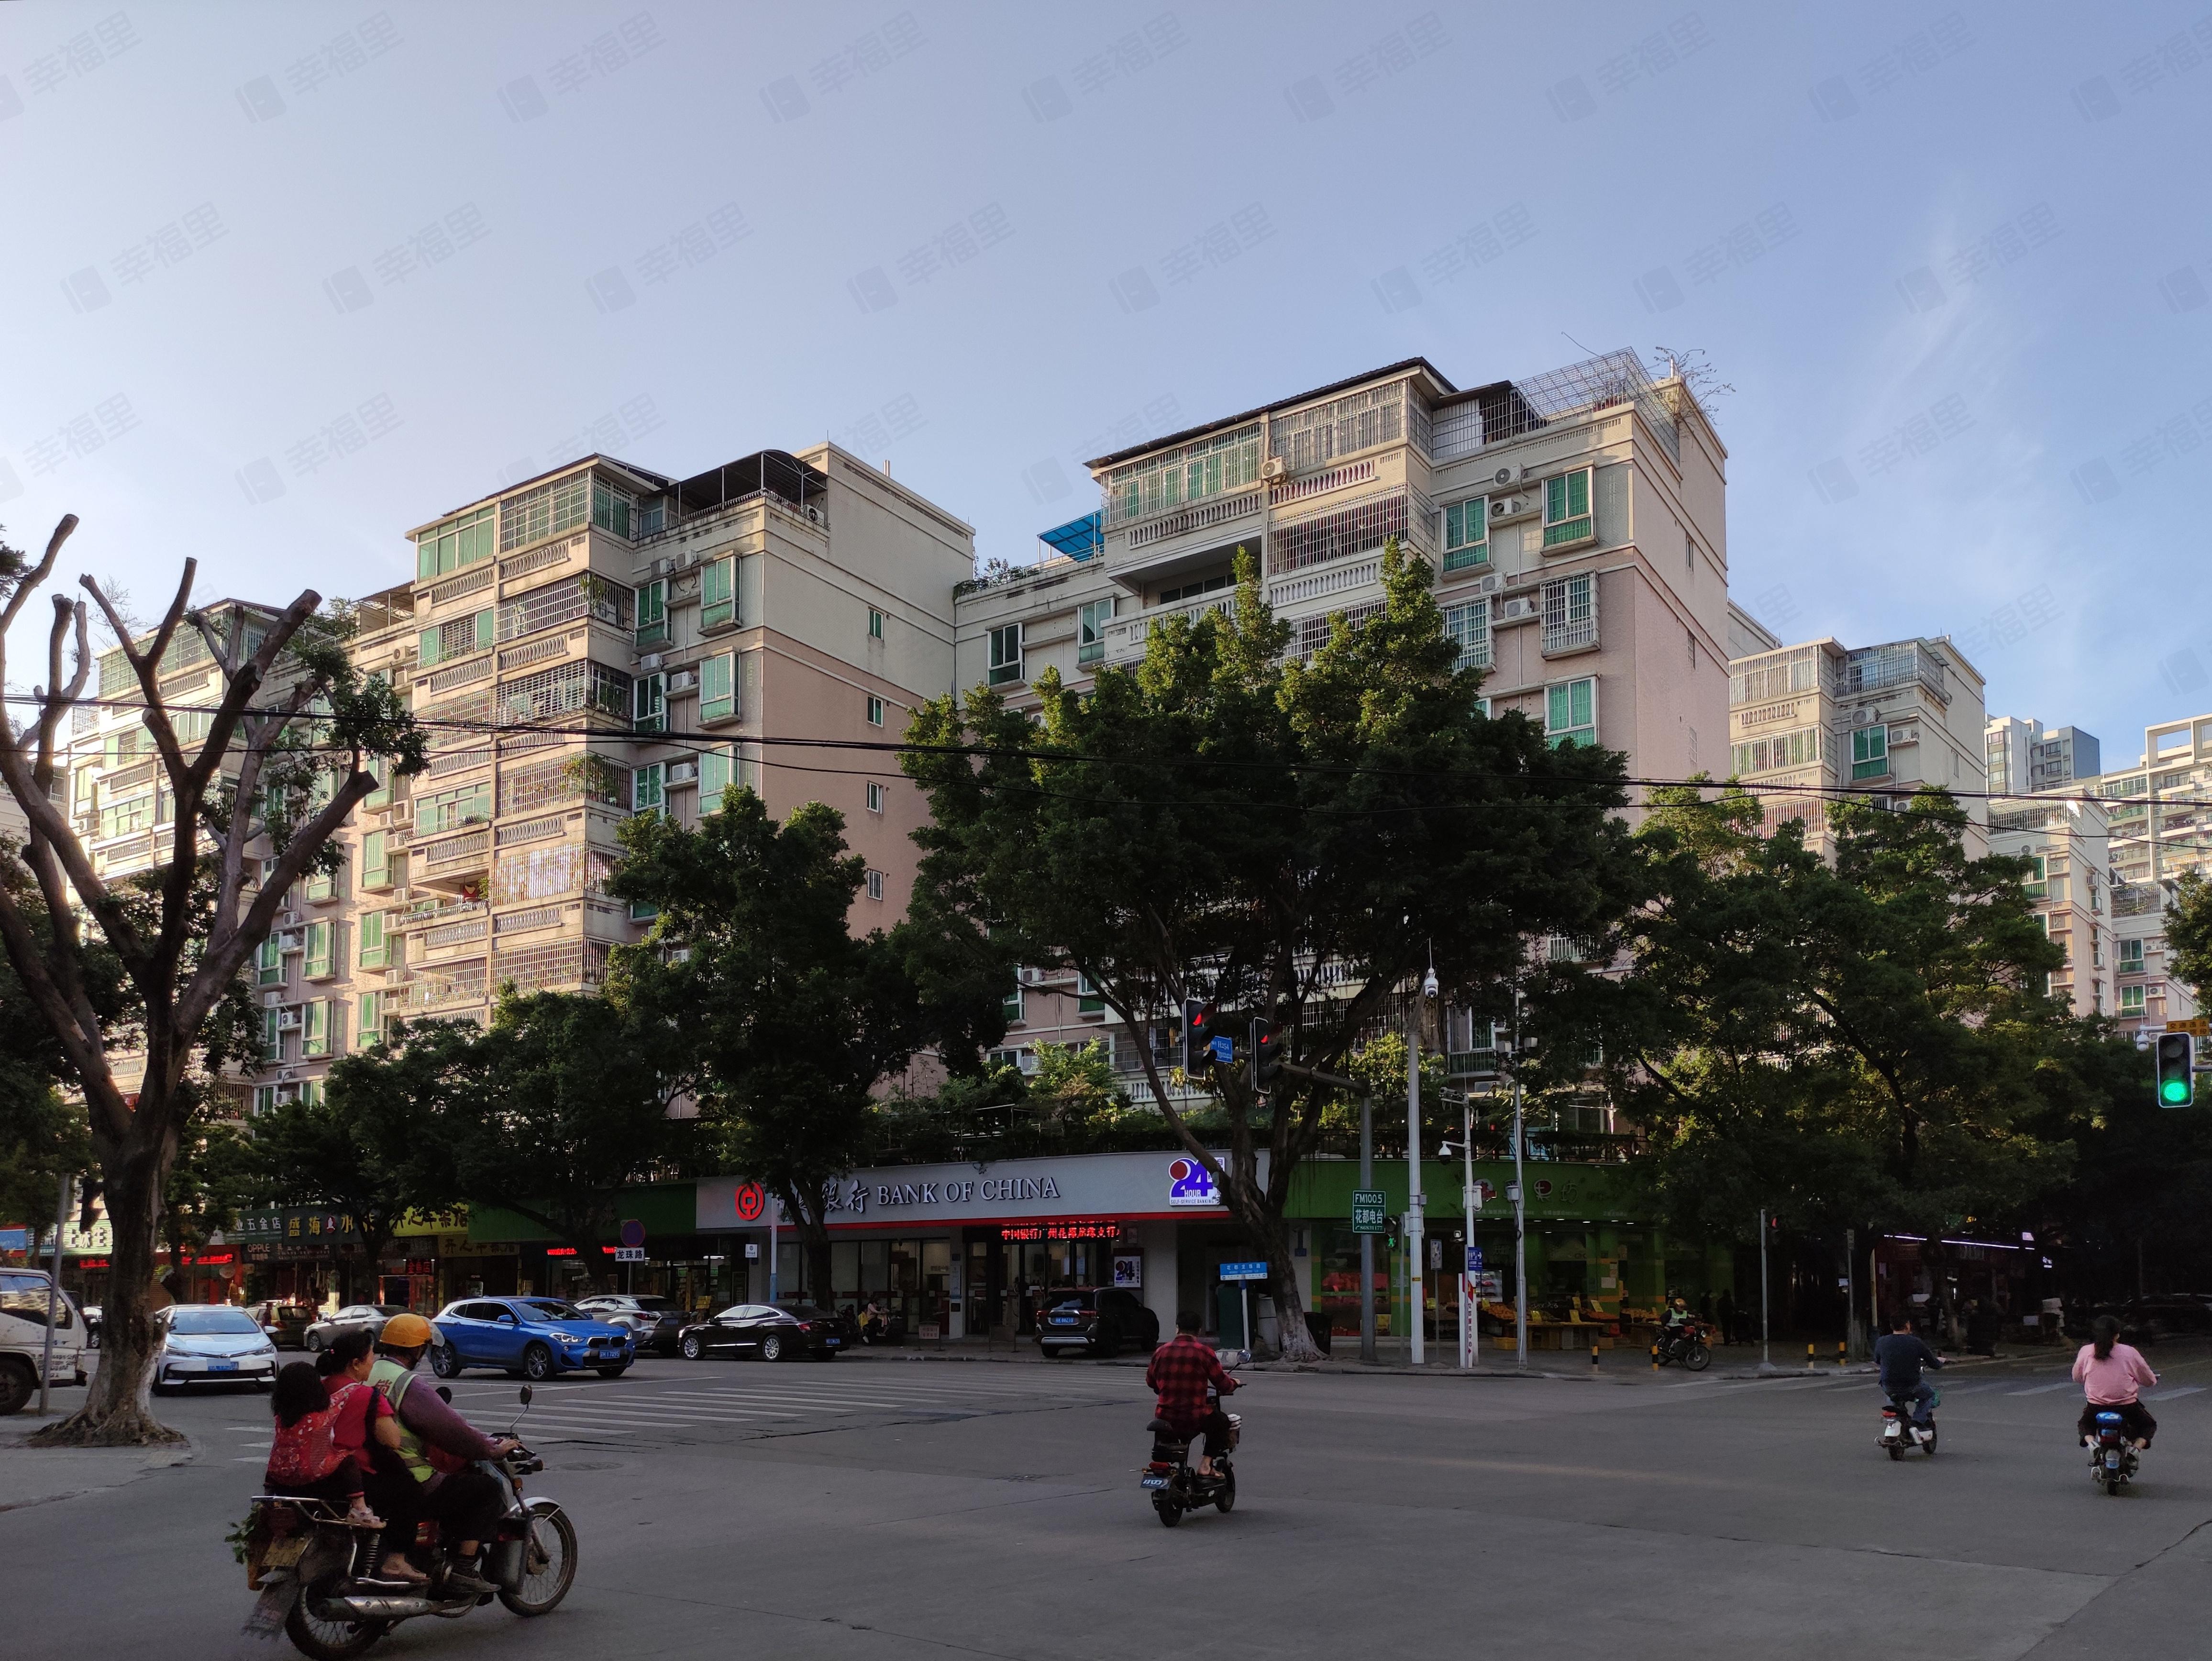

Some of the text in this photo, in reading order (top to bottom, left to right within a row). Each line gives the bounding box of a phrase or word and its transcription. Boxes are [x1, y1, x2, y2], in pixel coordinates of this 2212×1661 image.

[877, 1176, 1061, 1206] BANK OF CHINA
[1184, 1189, 1201, 1197] HOUR
[1355, 1194, 1382, 1204] FM100.5
[1355, 1209, 1383, 1224] 花都电台
[247, 1243, 270, 1253] OPPLE
[617, 1250, 643, 1260] 龙珠路
